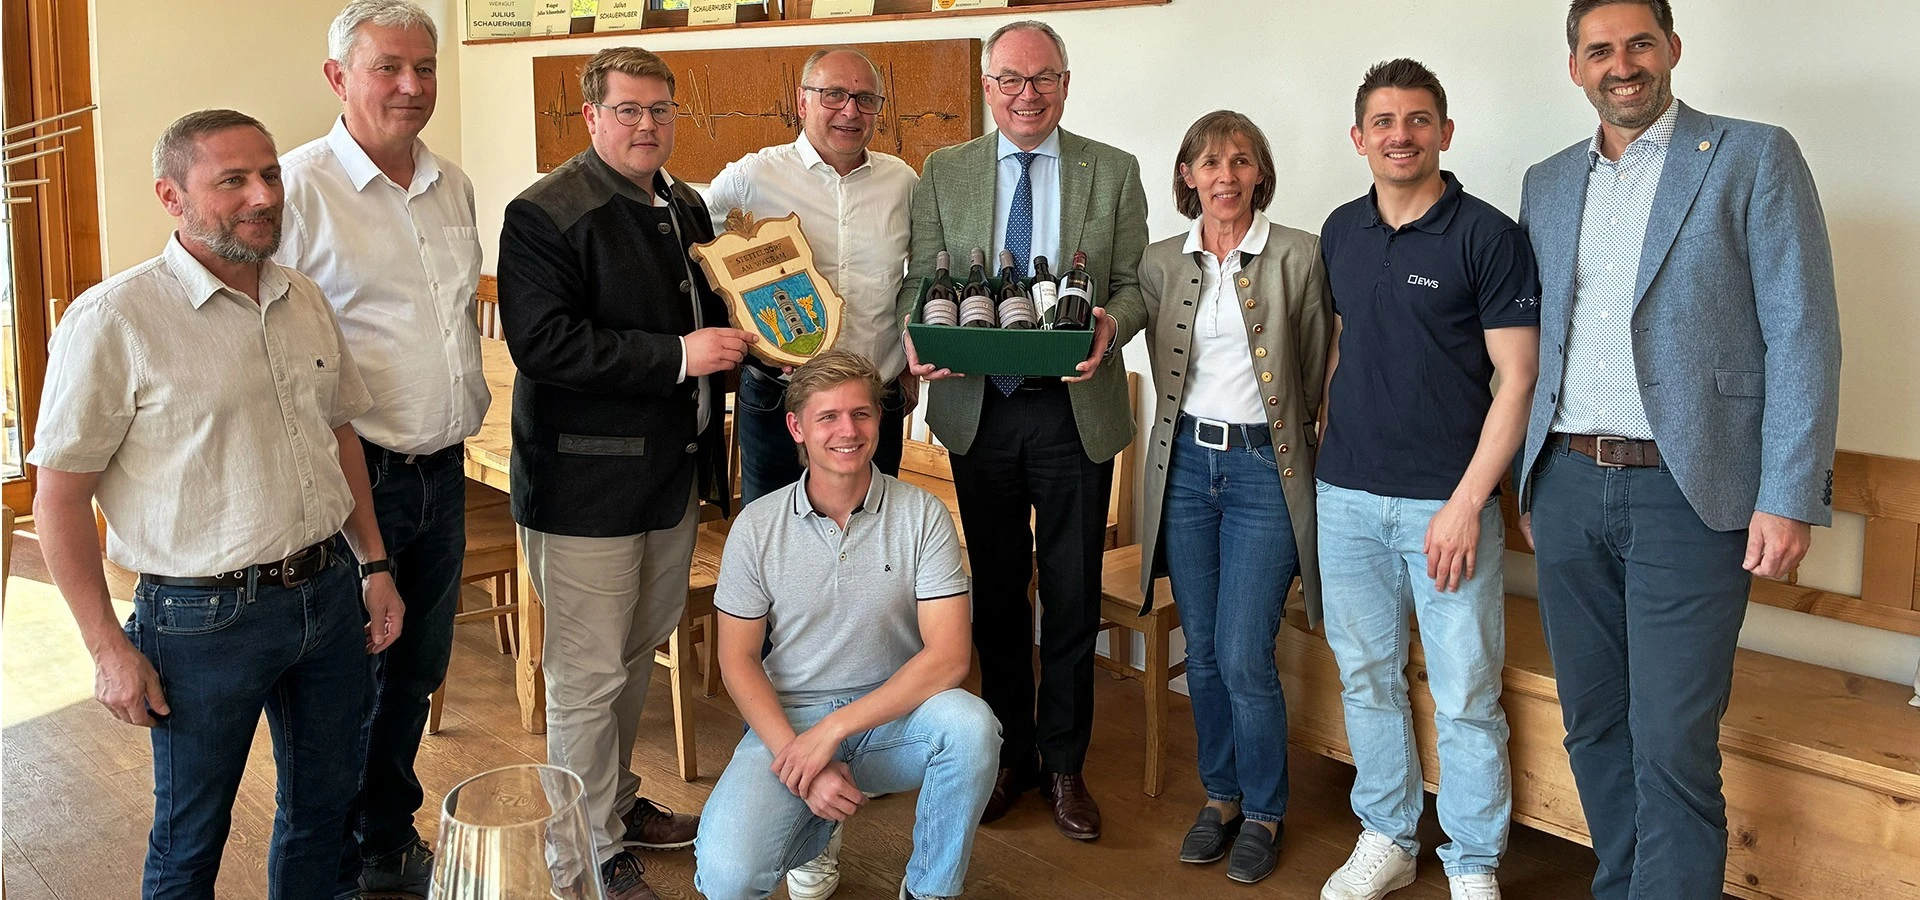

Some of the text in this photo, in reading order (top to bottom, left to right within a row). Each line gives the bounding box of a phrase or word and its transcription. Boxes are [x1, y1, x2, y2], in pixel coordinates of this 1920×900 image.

[692, 3, 732, 12] SCHAUERHUBER
[599, 10, 638, 19] SCHAUERHUBER
[735, 242, 782, 265] STETTELDORF
[742, 252, 787, 273] AM WAGRAM
[1417, 276, 1440, 289] EWS
